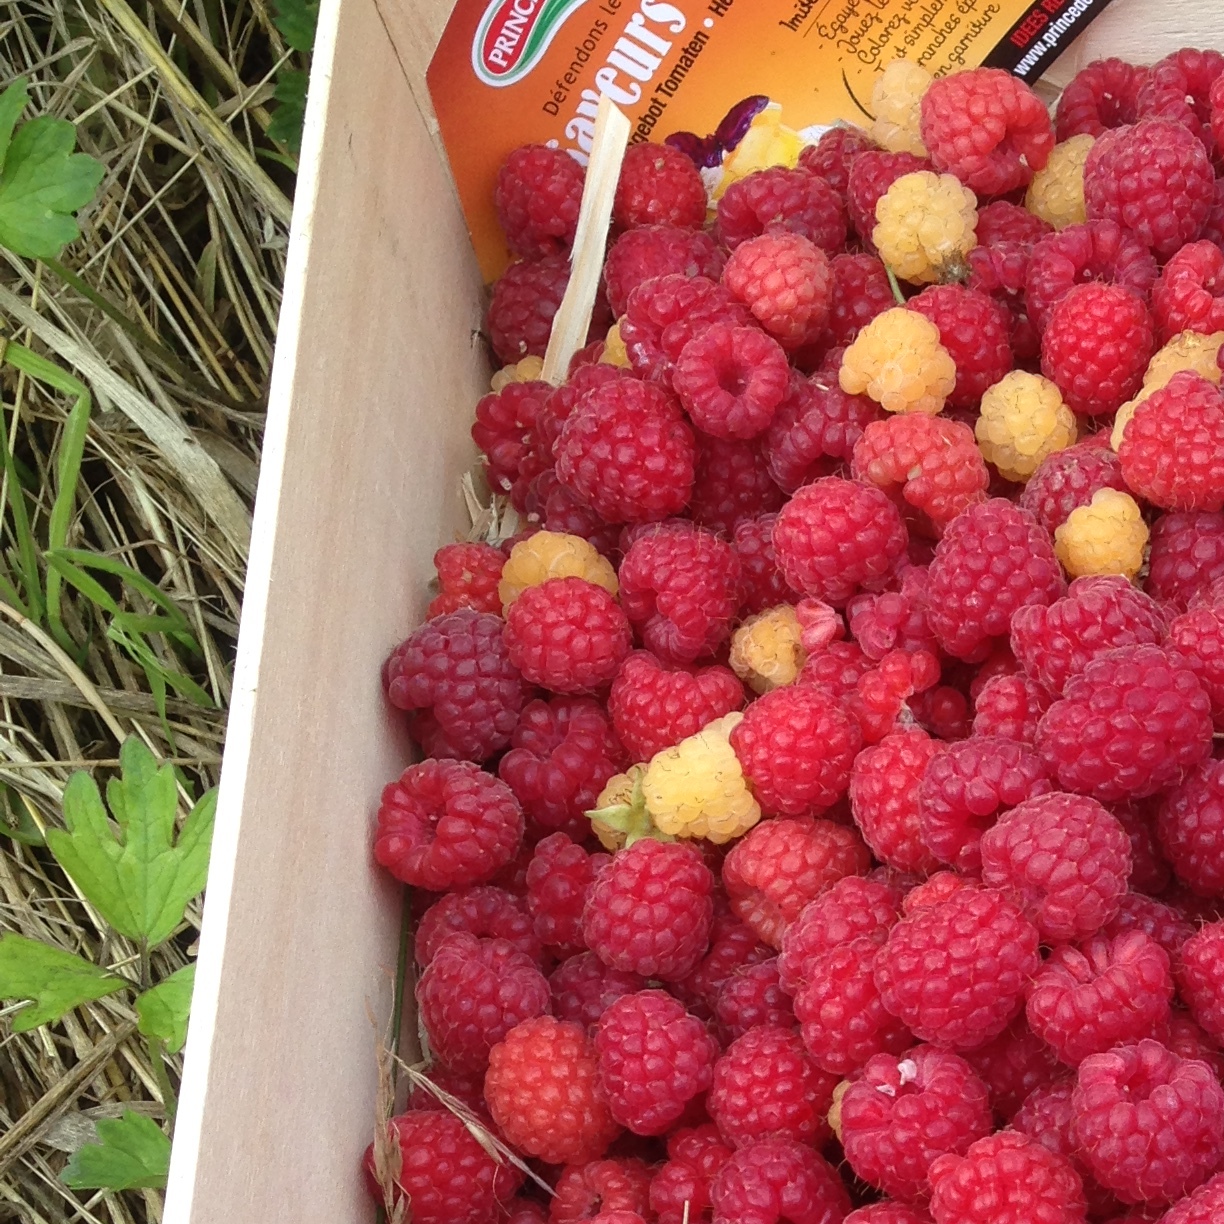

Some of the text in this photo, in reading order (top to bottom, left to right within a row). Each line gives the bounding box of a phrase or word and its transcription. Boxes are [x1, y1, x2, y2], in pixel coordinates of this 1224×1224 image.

[487, 0, 548, 68] PRINC
[836, 11, 883, 55] Jouez
[856, 12, 907, 65] Colorez
[904, 0, 947, 46] simple
[947, 3, 1001, 66] garniture
[1009, 8, 1050, 49] IDEES
[542, 20, 608, 117] Défendons
[654, 30, 710, 101] Tomaten
